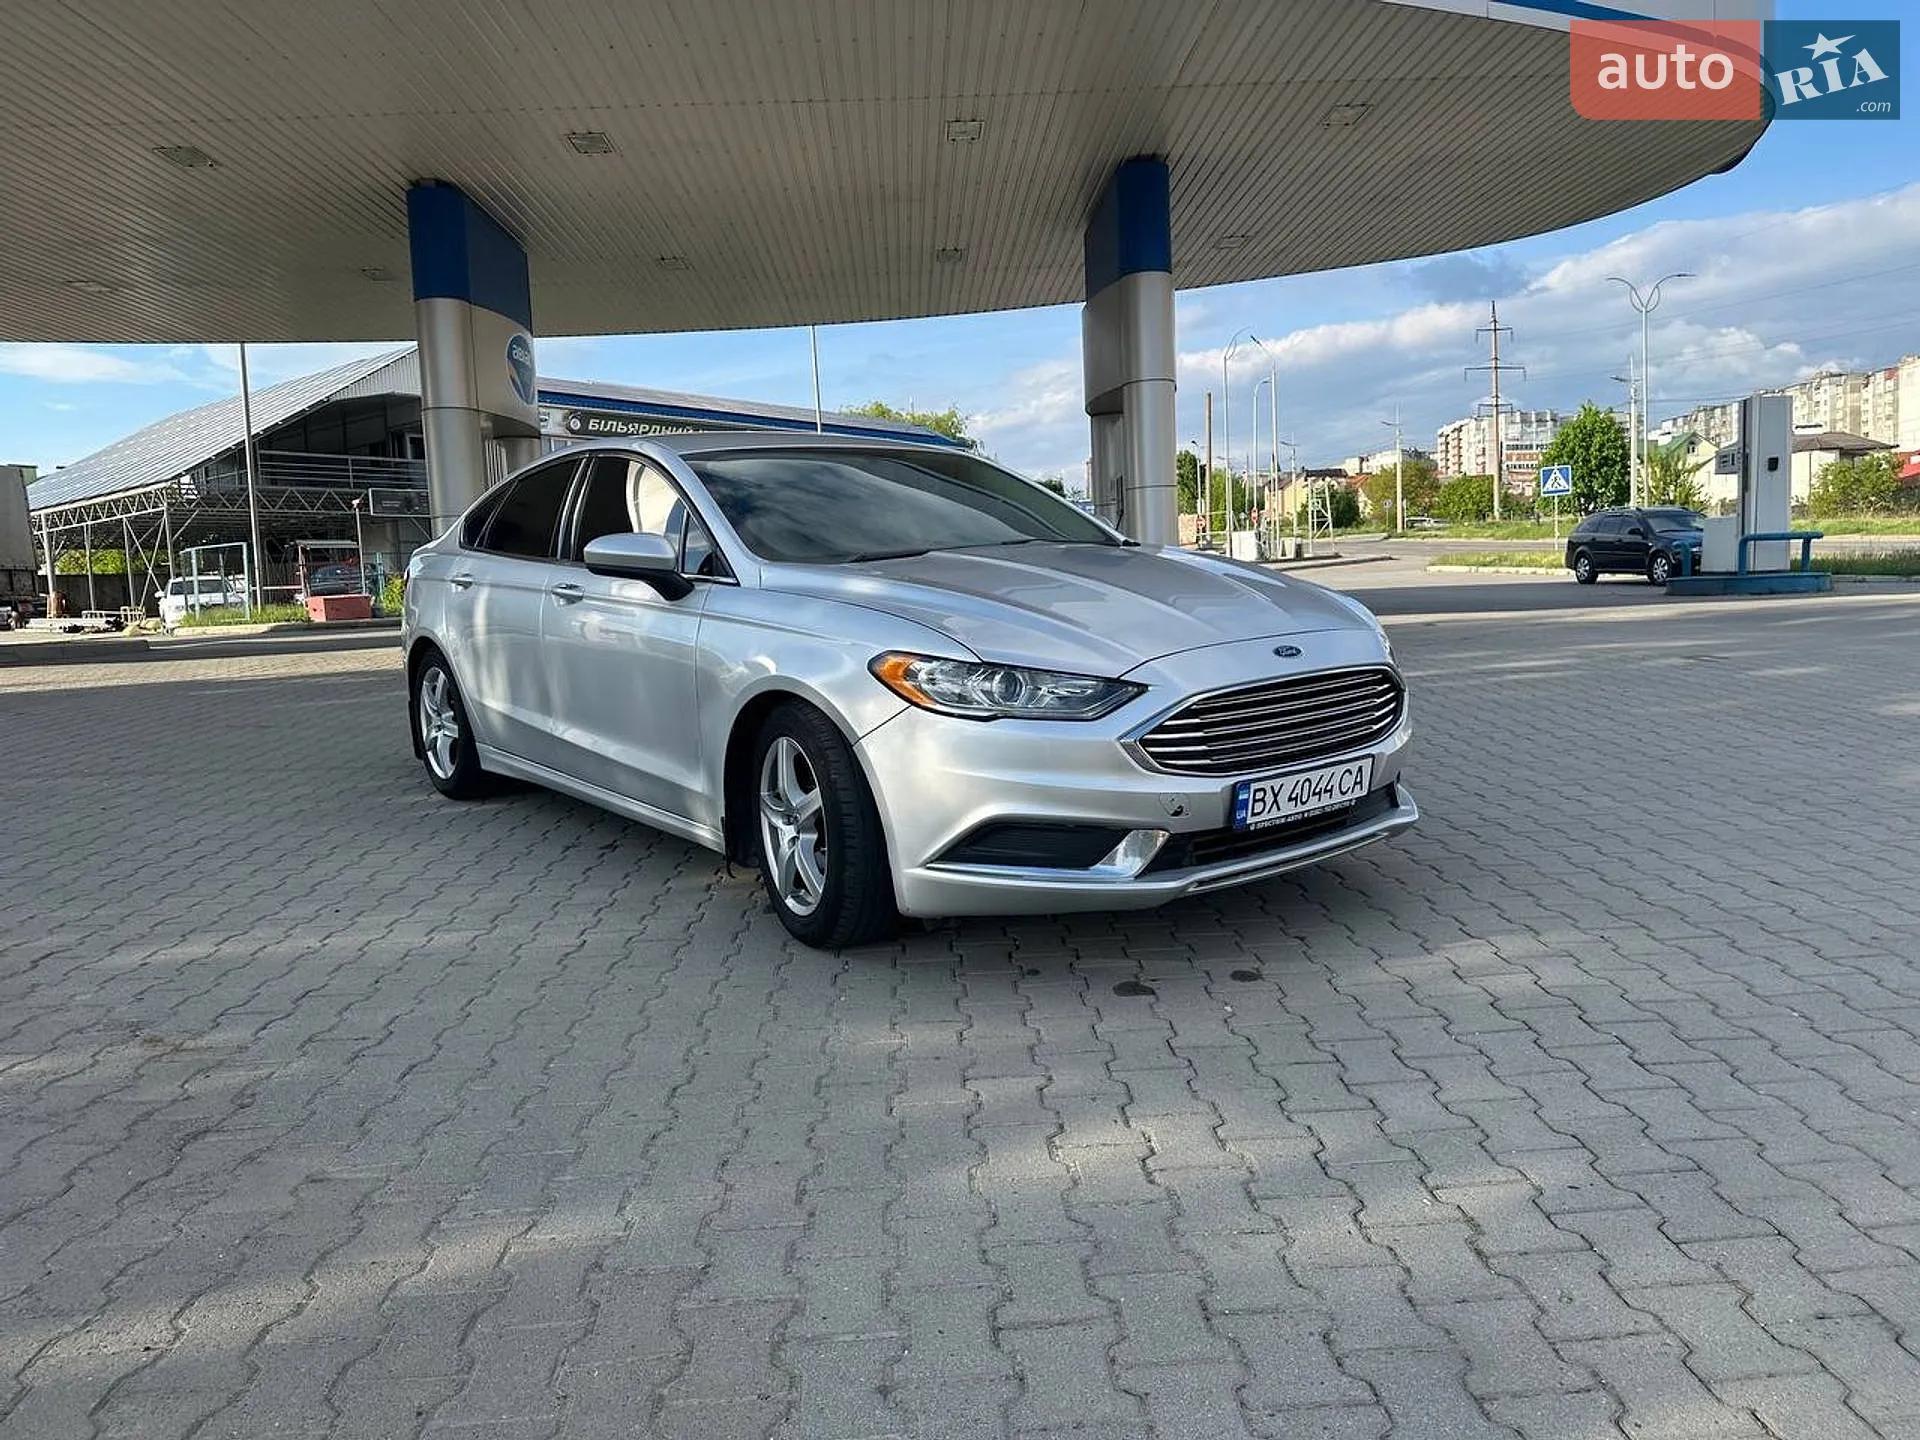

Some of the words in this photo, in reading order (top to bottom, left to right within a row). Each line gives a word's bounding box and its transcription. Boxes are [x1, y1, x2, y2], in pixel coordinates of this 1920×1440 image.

[1251, 784, 1283, 817] BX
[1287, 772, 1335, 808] 4044
[1339, 765, 1363, 796] CA
